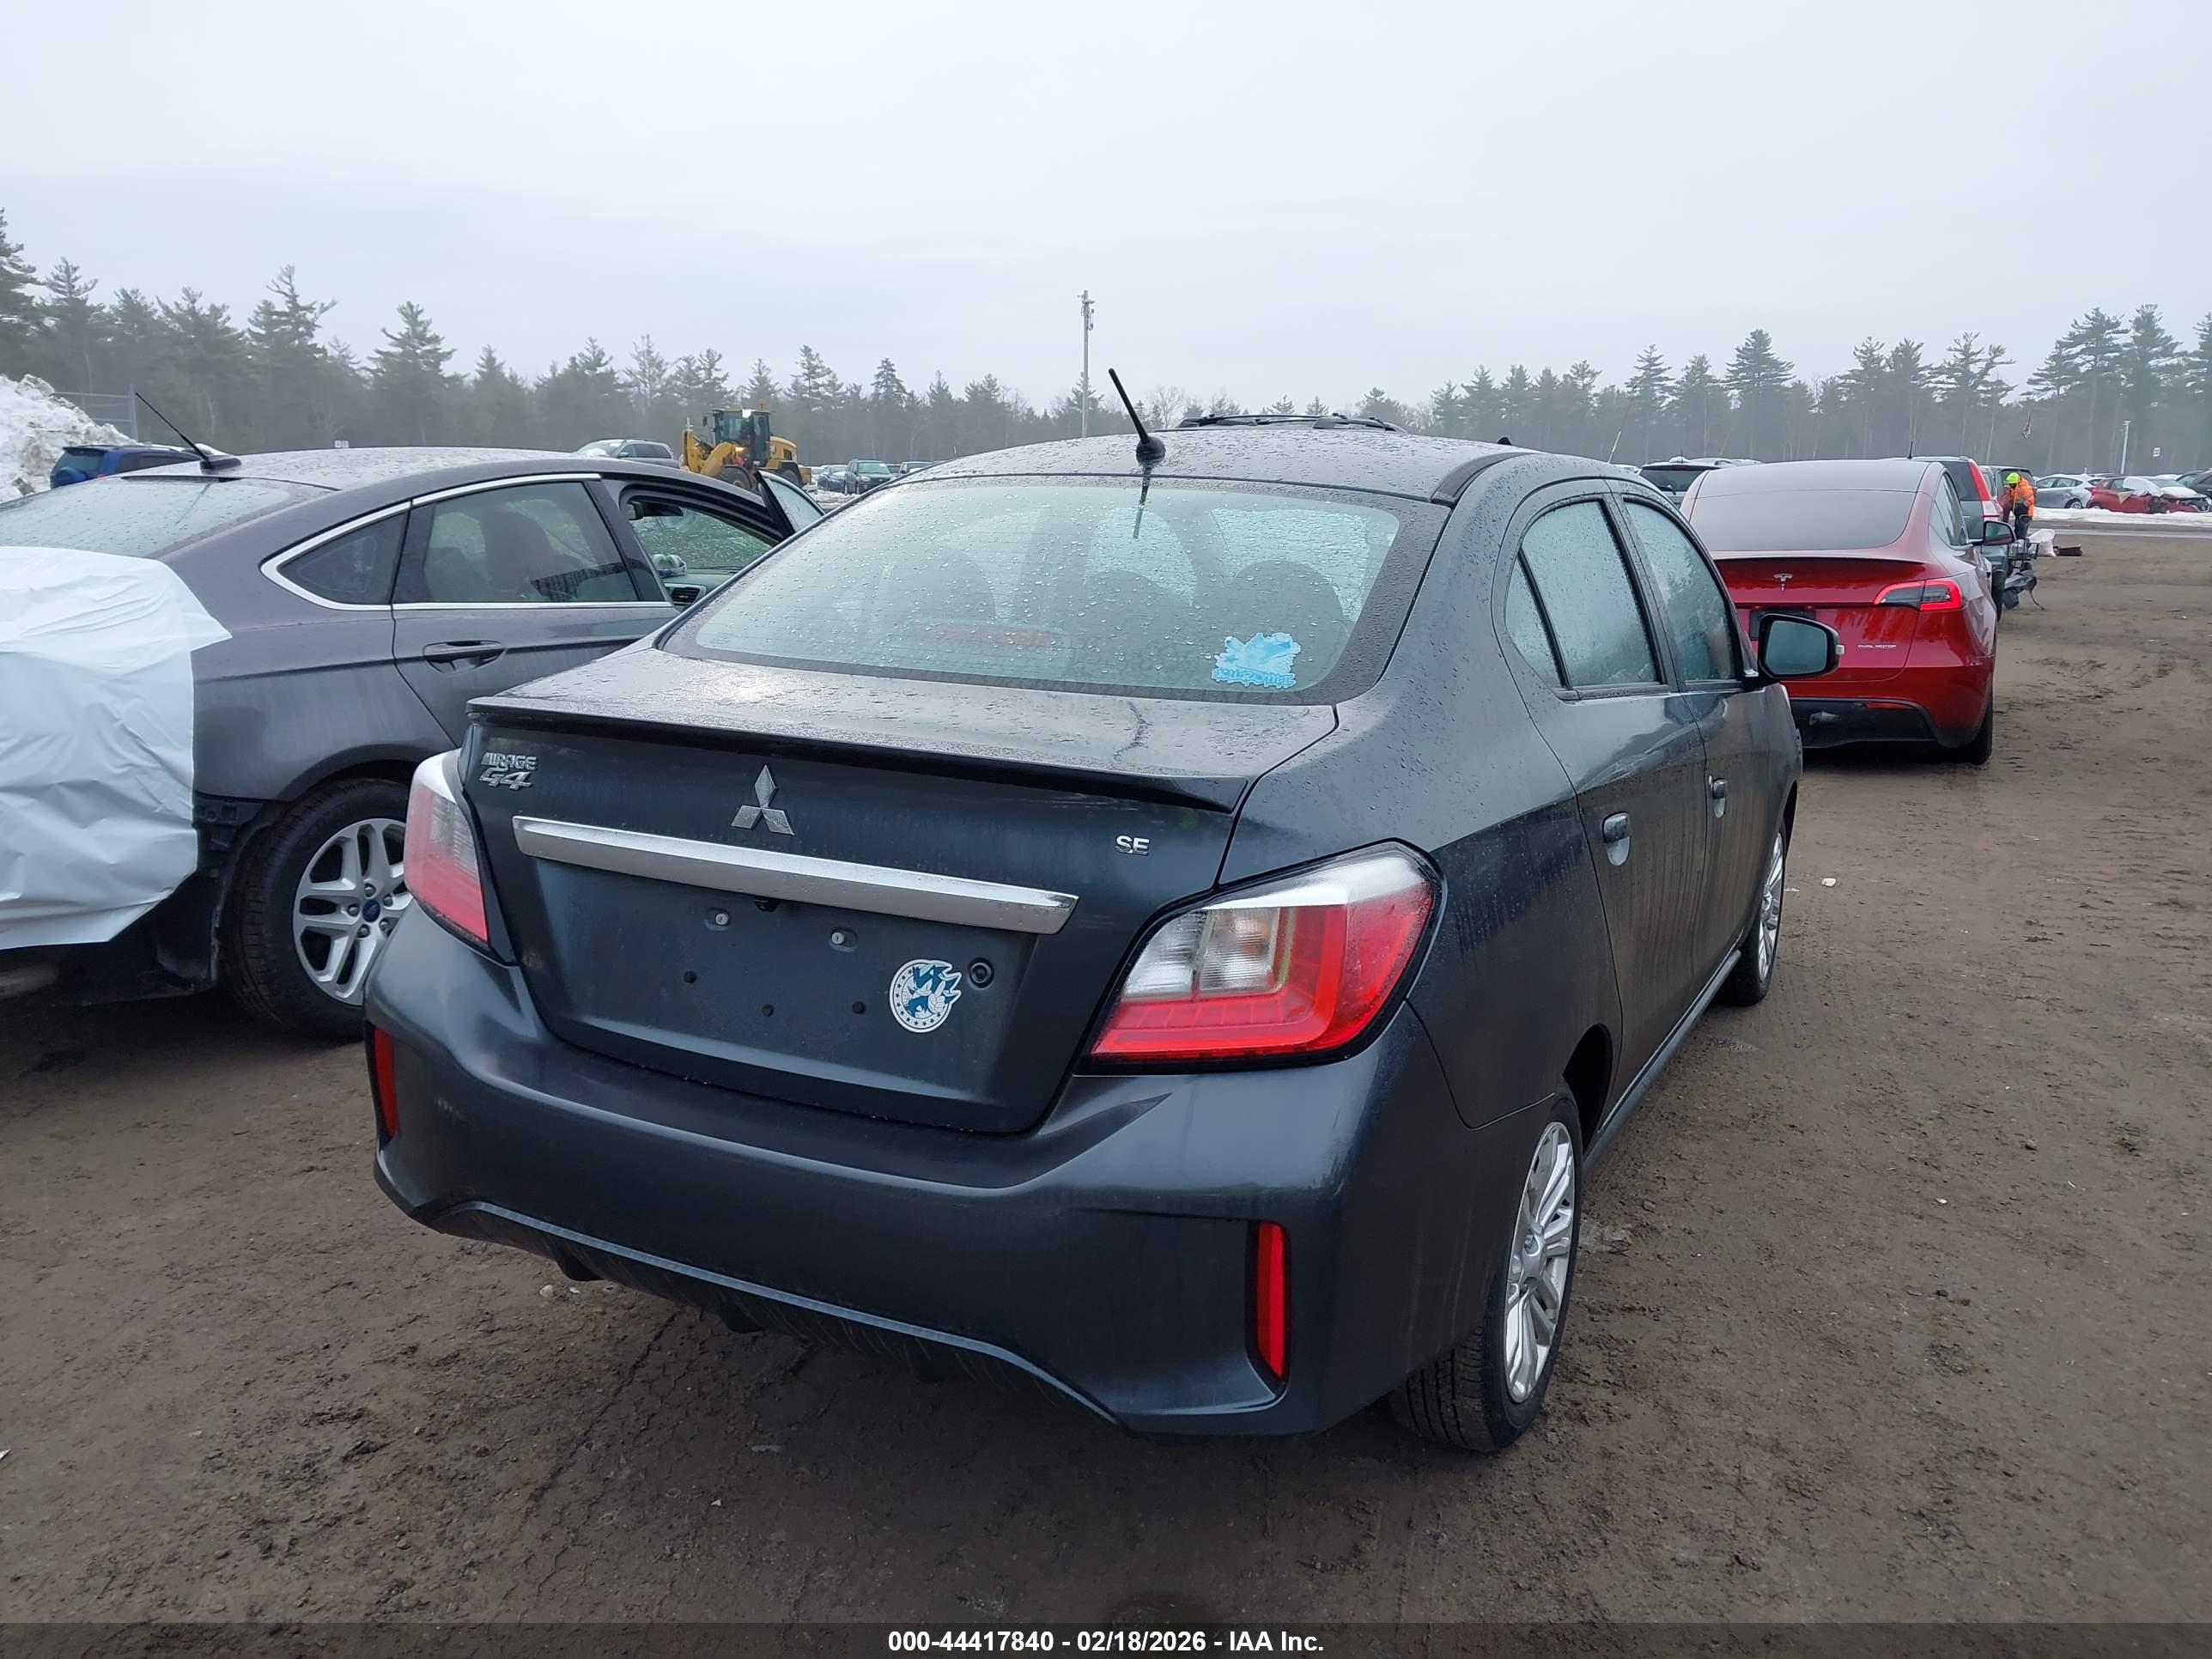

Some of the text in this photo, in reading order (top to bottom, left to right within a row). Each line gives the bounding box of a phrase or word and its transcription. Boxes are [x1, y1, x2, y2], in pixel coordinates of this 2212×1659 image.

[481, 752, 537, 770] MIRAGE
[479, 766, 532, 790] G4
[1115, 836, 1150, 855] SE
